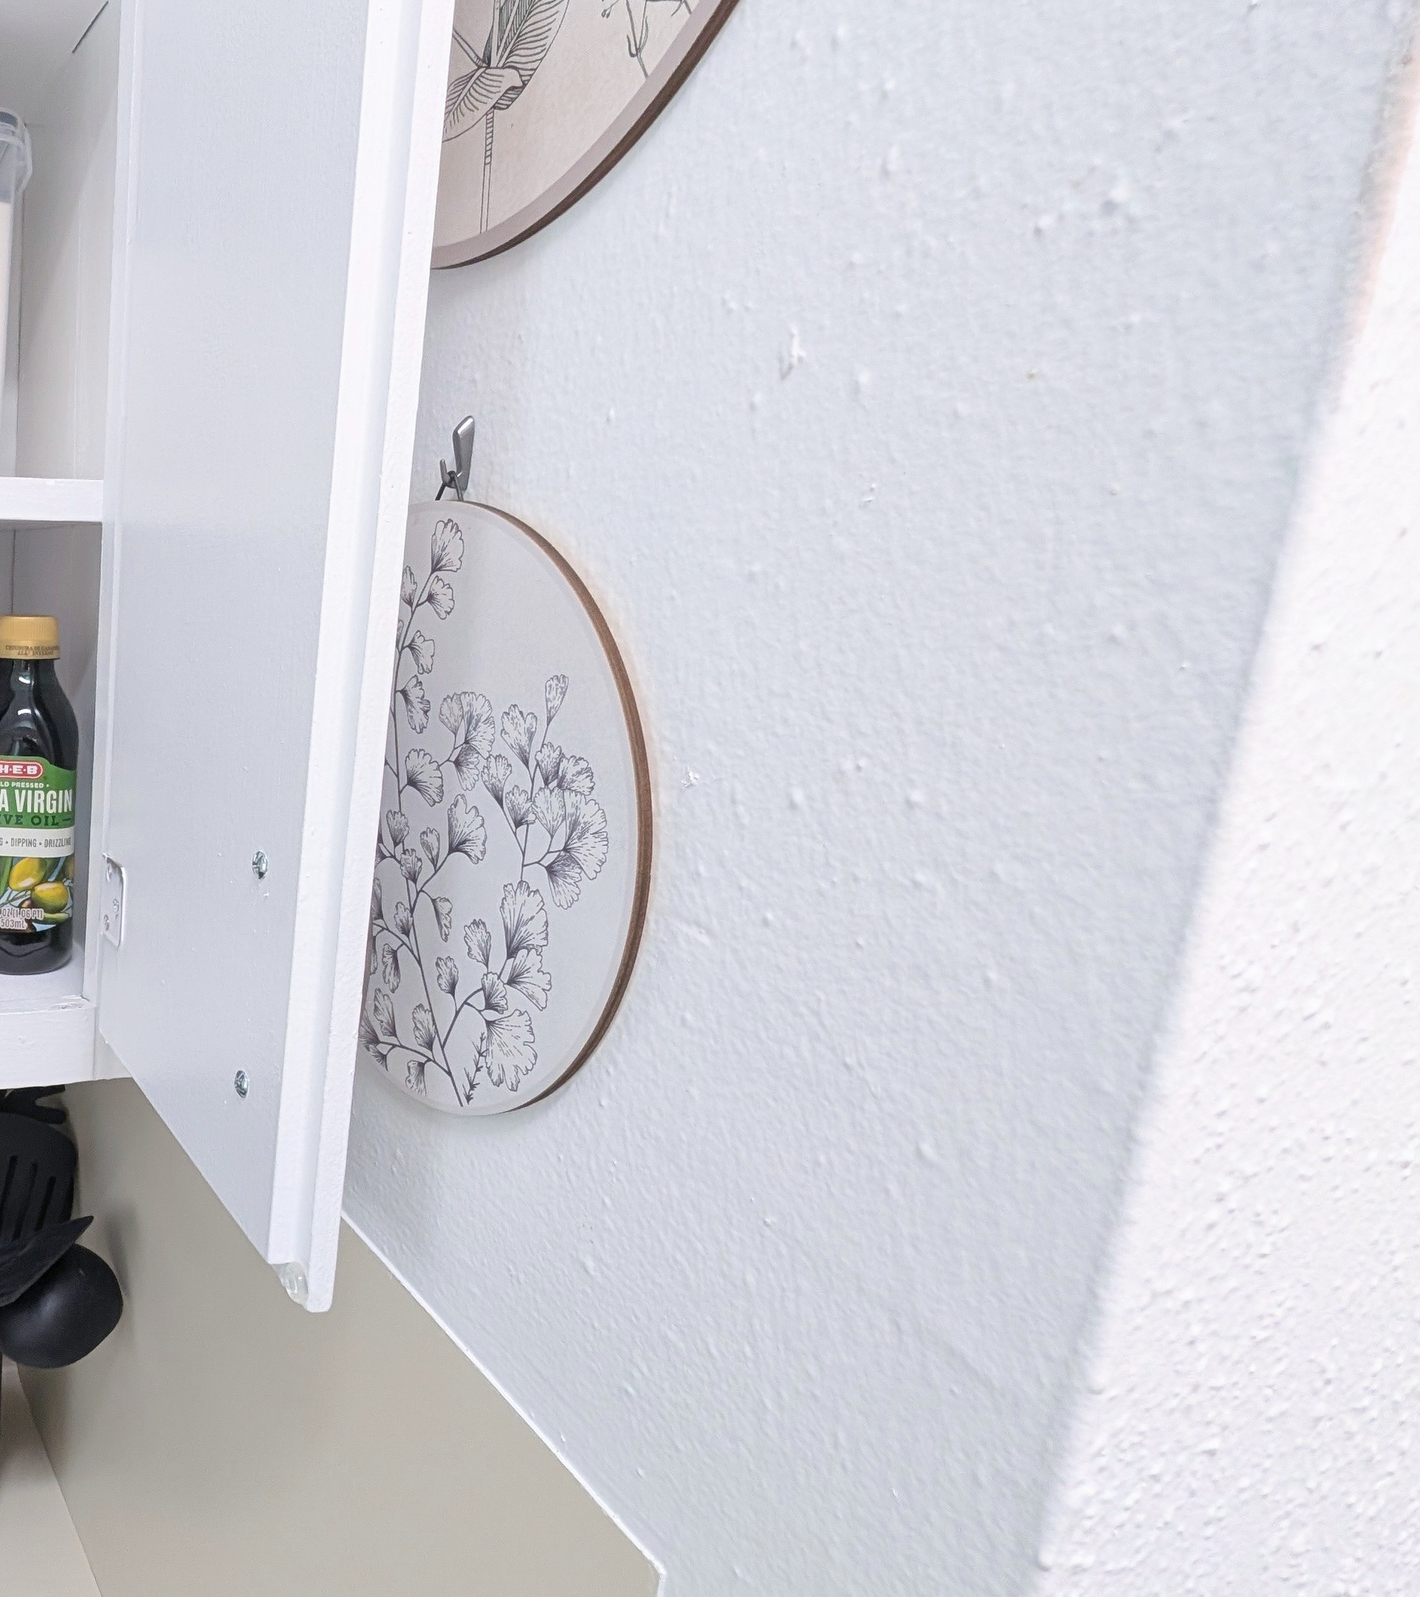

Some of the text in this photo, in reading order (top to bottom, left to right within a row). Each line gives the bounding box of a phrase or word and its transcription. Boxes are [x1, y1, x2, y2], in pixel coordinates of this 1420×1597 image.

[15, 789, 73, 813] VIRGIN
[31, 815, 59, 826] OIL
[11, 838, 37, 847] DIPPING
[0, 920, 26, 929] 503mL
